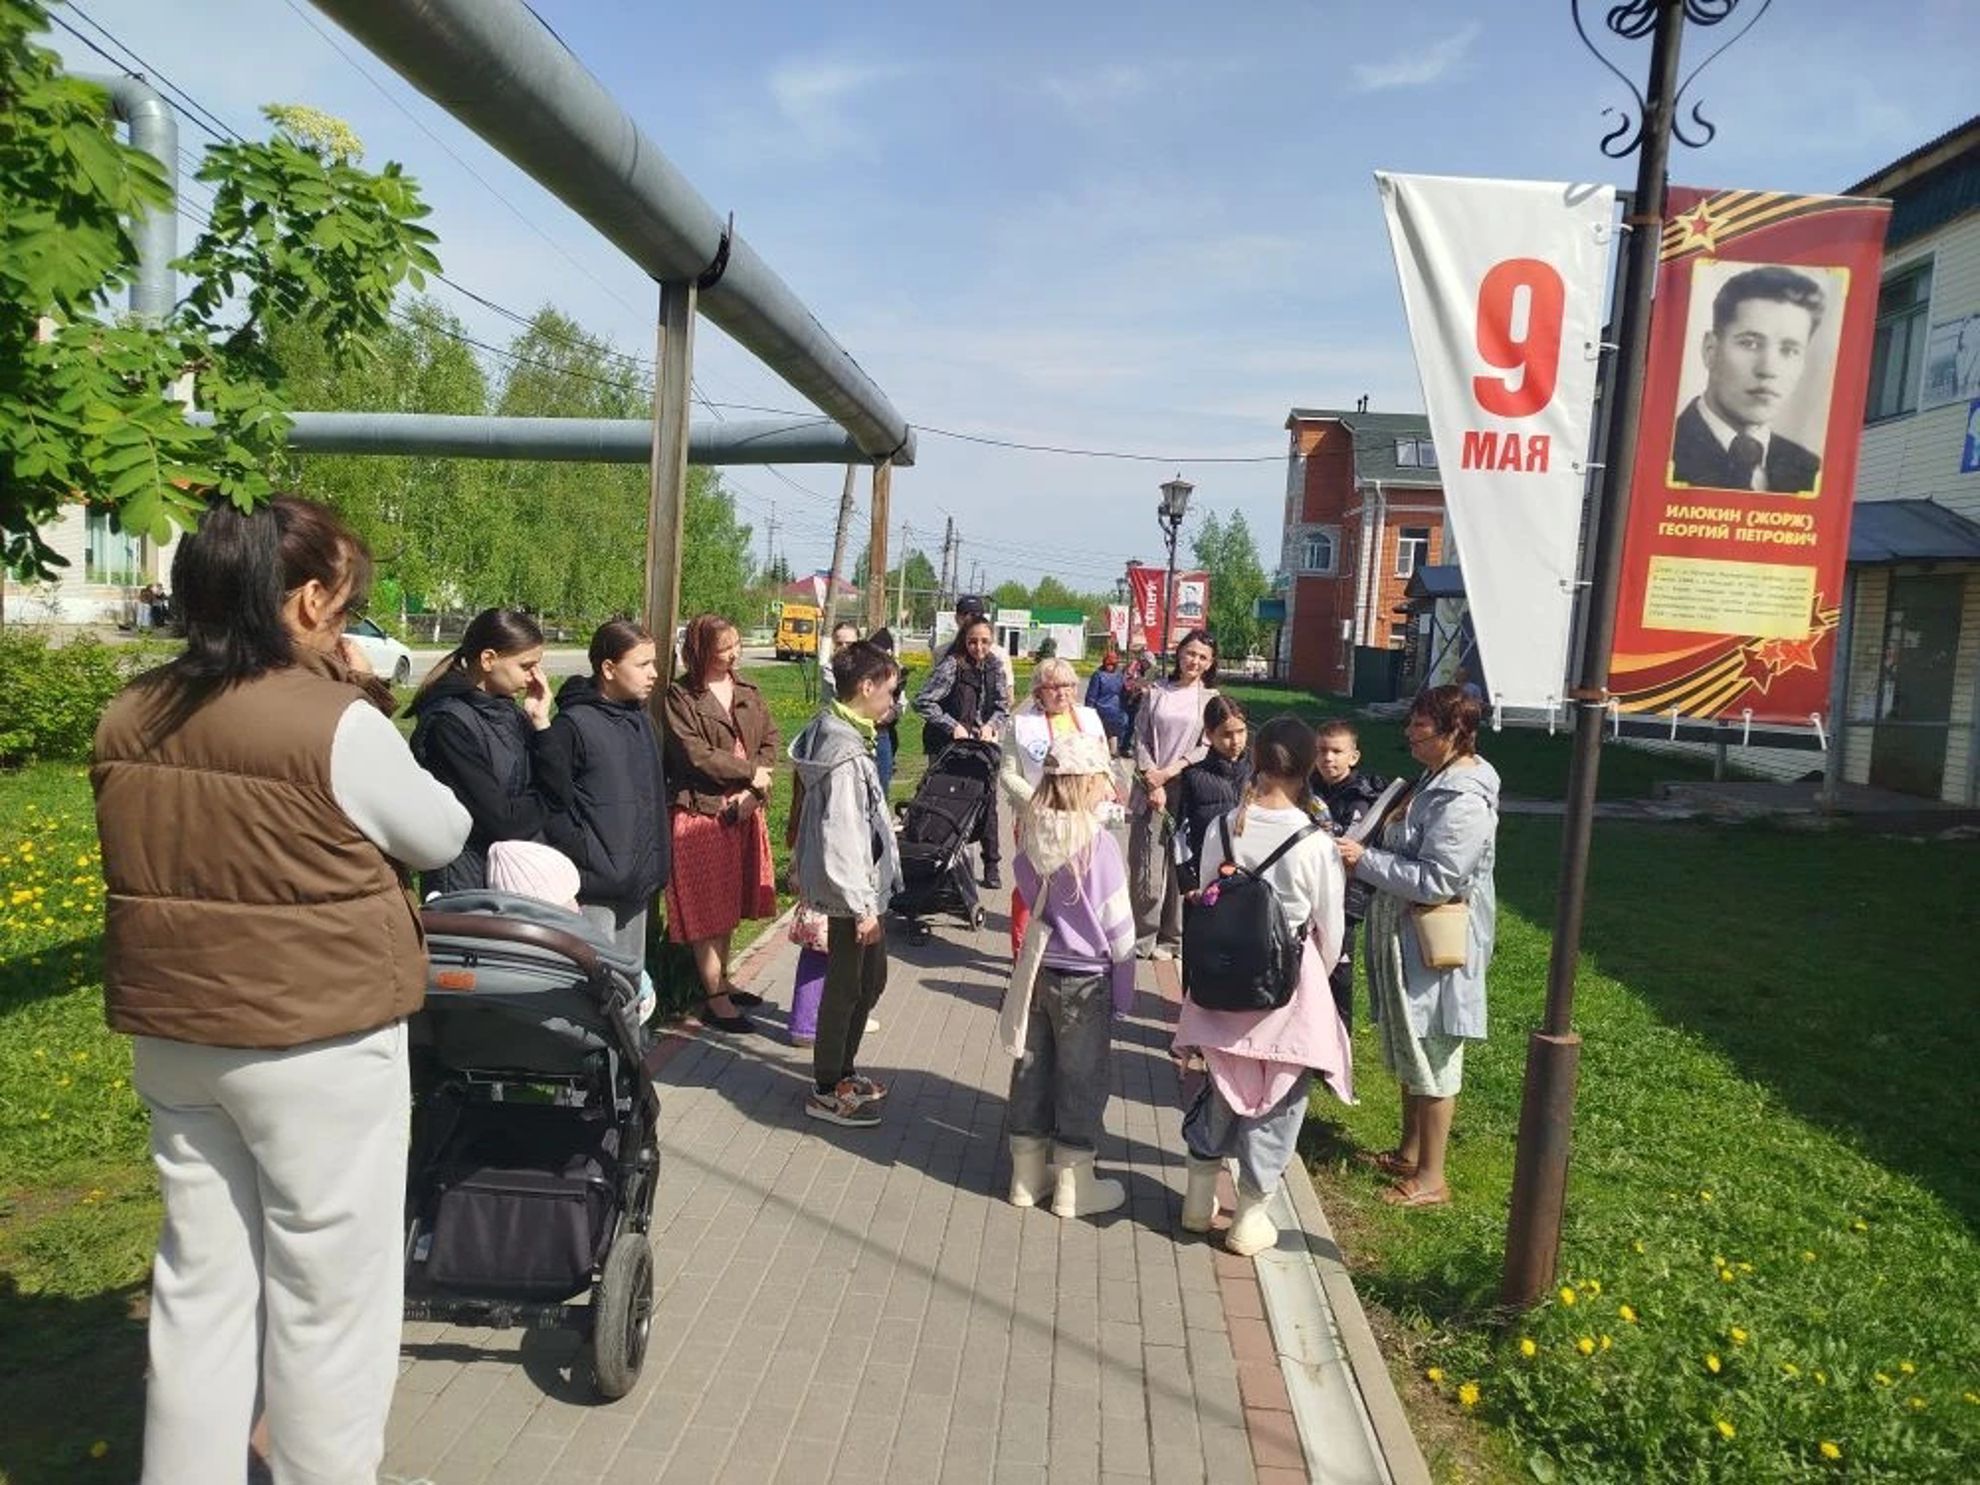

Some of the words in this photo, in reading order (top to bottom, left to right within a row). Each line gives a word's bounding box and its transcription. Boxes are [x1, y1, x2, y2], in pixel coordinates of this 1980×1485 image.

[1473, 257, 1565, 418] 9
[1461, 431, 1551, 473] МАЯ
[1658, 522, 1730, 540] ГЕОРГИЙ
[1735, 528, 1818, 546] ПЕТРОВИЧ
[1665, 504, 1742, 522] ИЛЮКИН
[1746, 510, 1814, 530] (ЖОРЖ)
